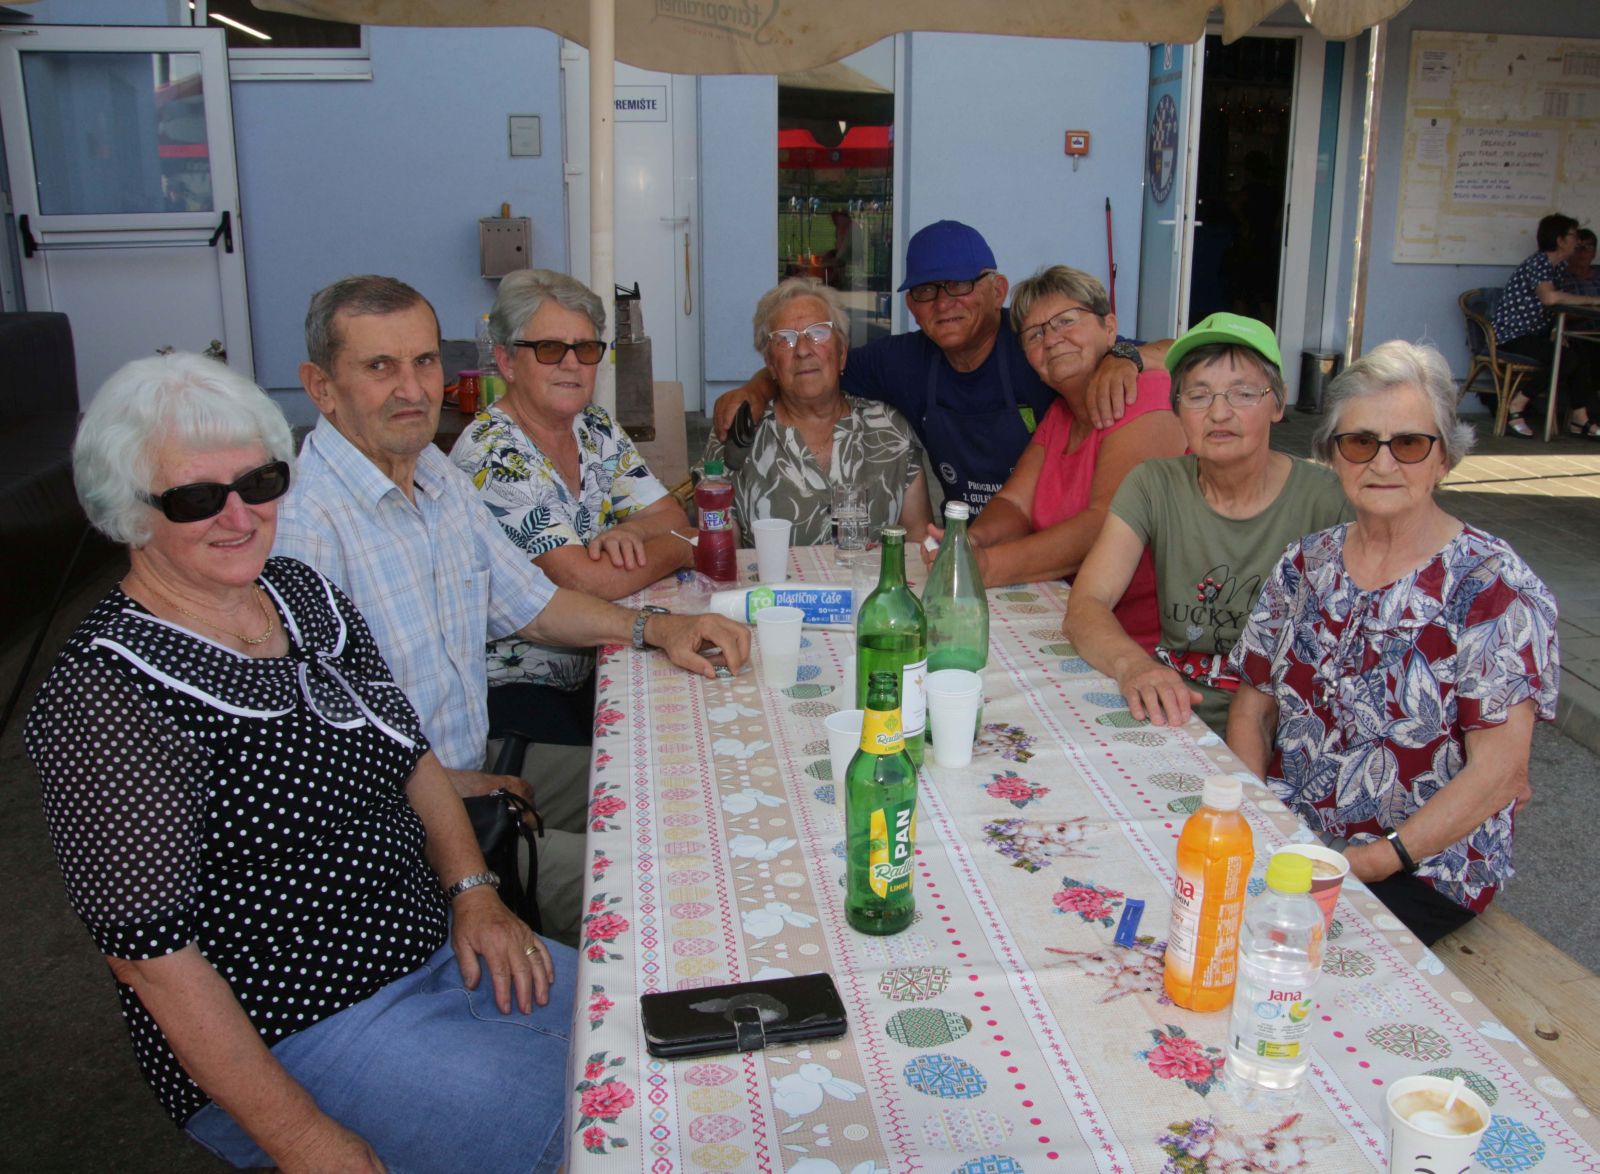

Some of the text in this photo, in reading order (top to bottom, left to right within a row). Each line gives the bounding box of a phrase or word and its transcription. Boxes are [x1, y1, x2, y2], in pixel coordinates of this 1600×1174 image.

[613, 97, 657, 110] REMIŠTE
[703, 511, 719, 520] ICE
[707, 519, 724, 527] TEA
[776, 591, 842, 606] plastične čaše
[894, 808, 911, 861] PAN
[1267, 989, 1303, 1002] Jana
